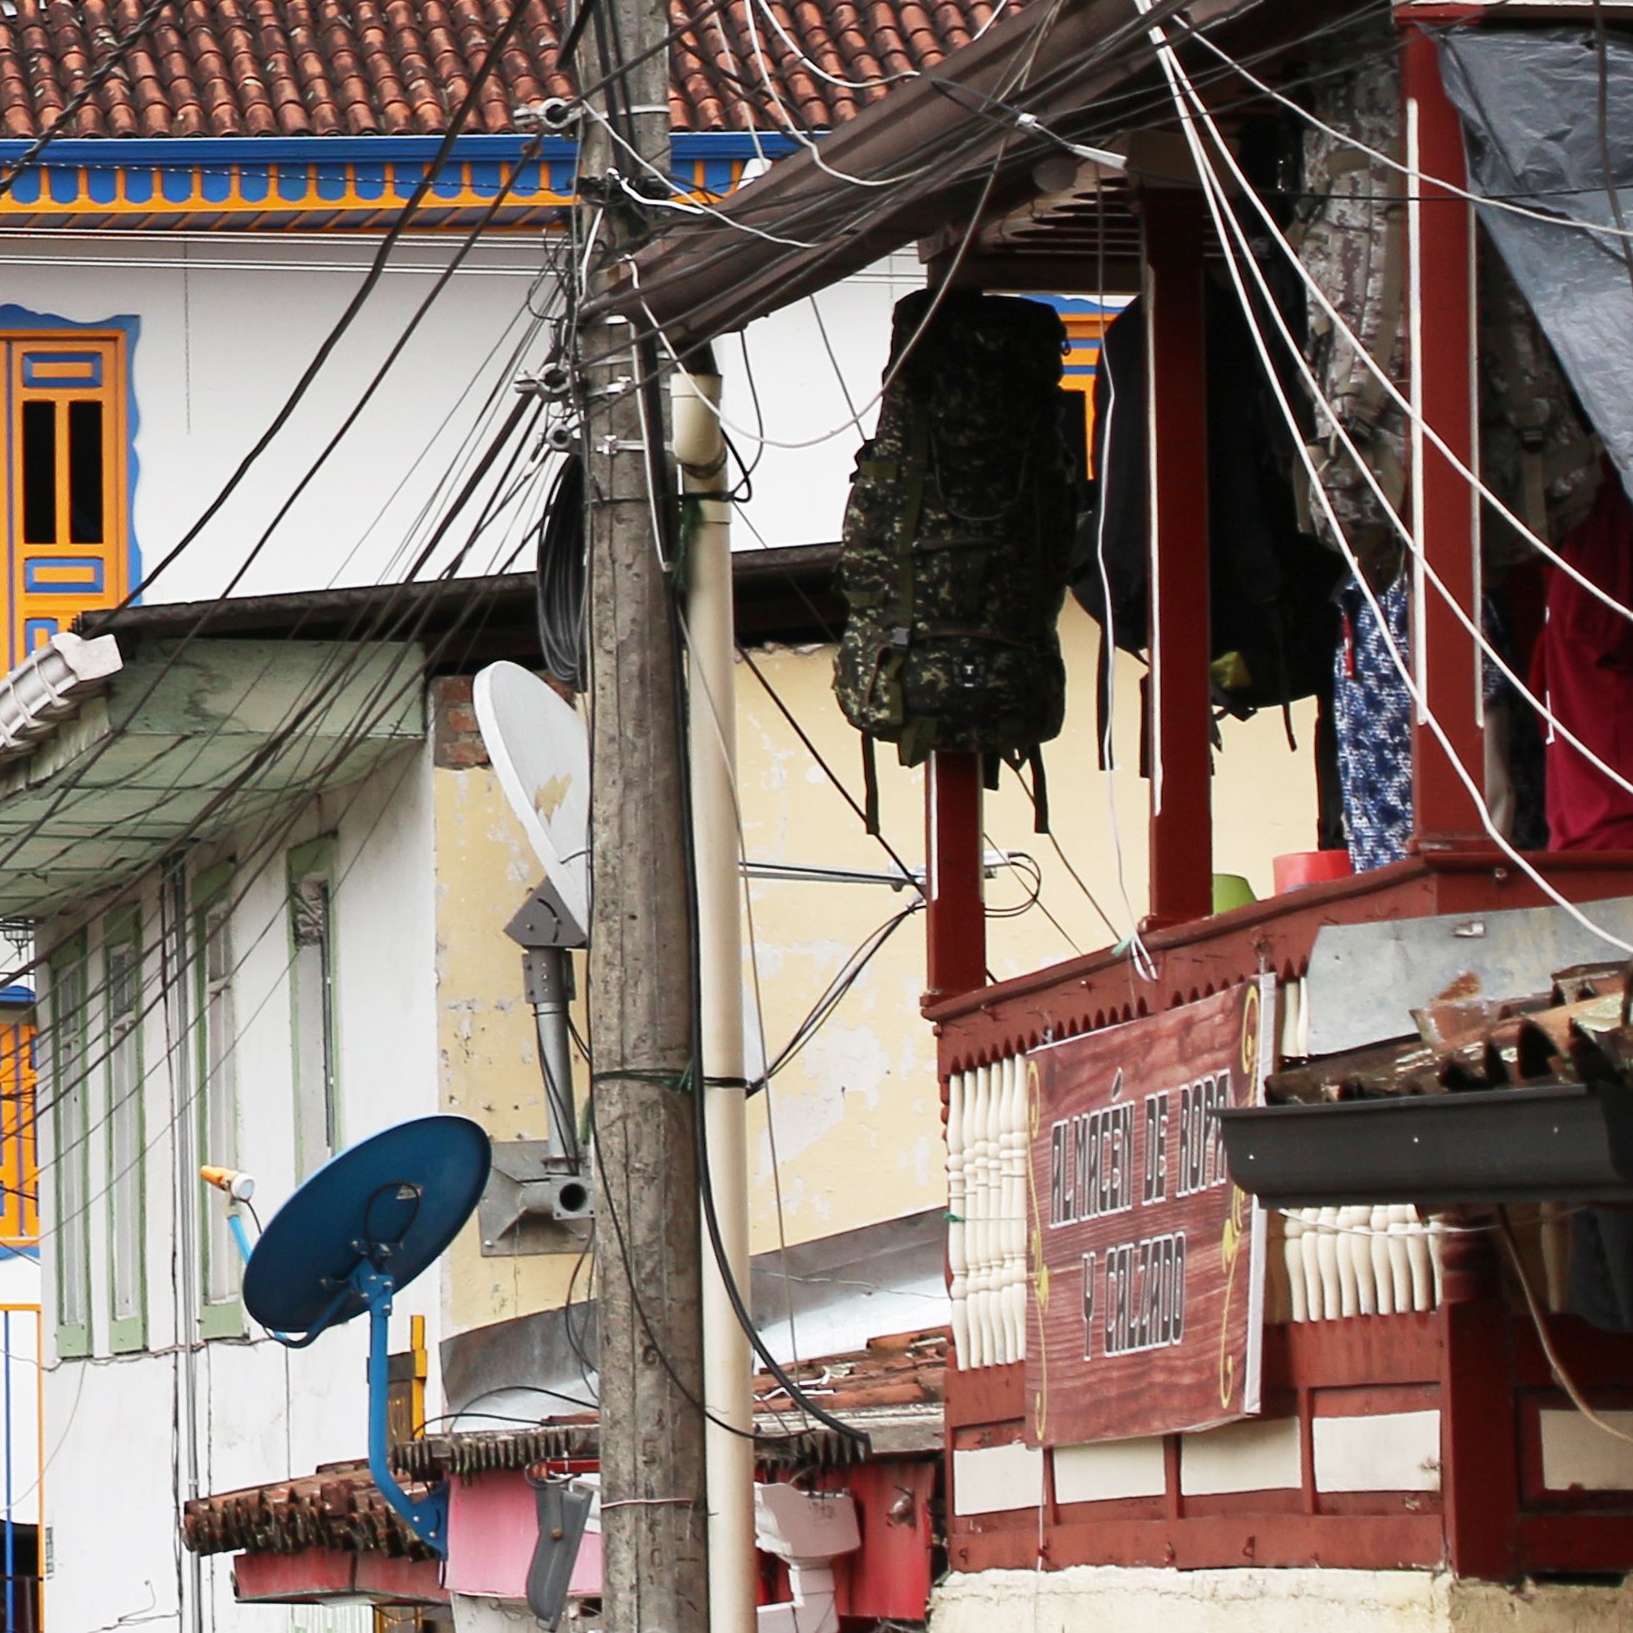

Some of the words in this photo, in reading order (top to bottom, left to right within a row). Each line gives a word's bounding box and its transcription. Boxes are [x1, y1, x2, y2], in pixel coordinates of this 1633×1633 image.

[1048, 1067, 1135, 1229] ALMACÉN
[1141, 1090, 1170, 1206] DE
[1082, 1251, 1096, 1362] Y
[1104, 1231, 1186, 1358] CALZADO
